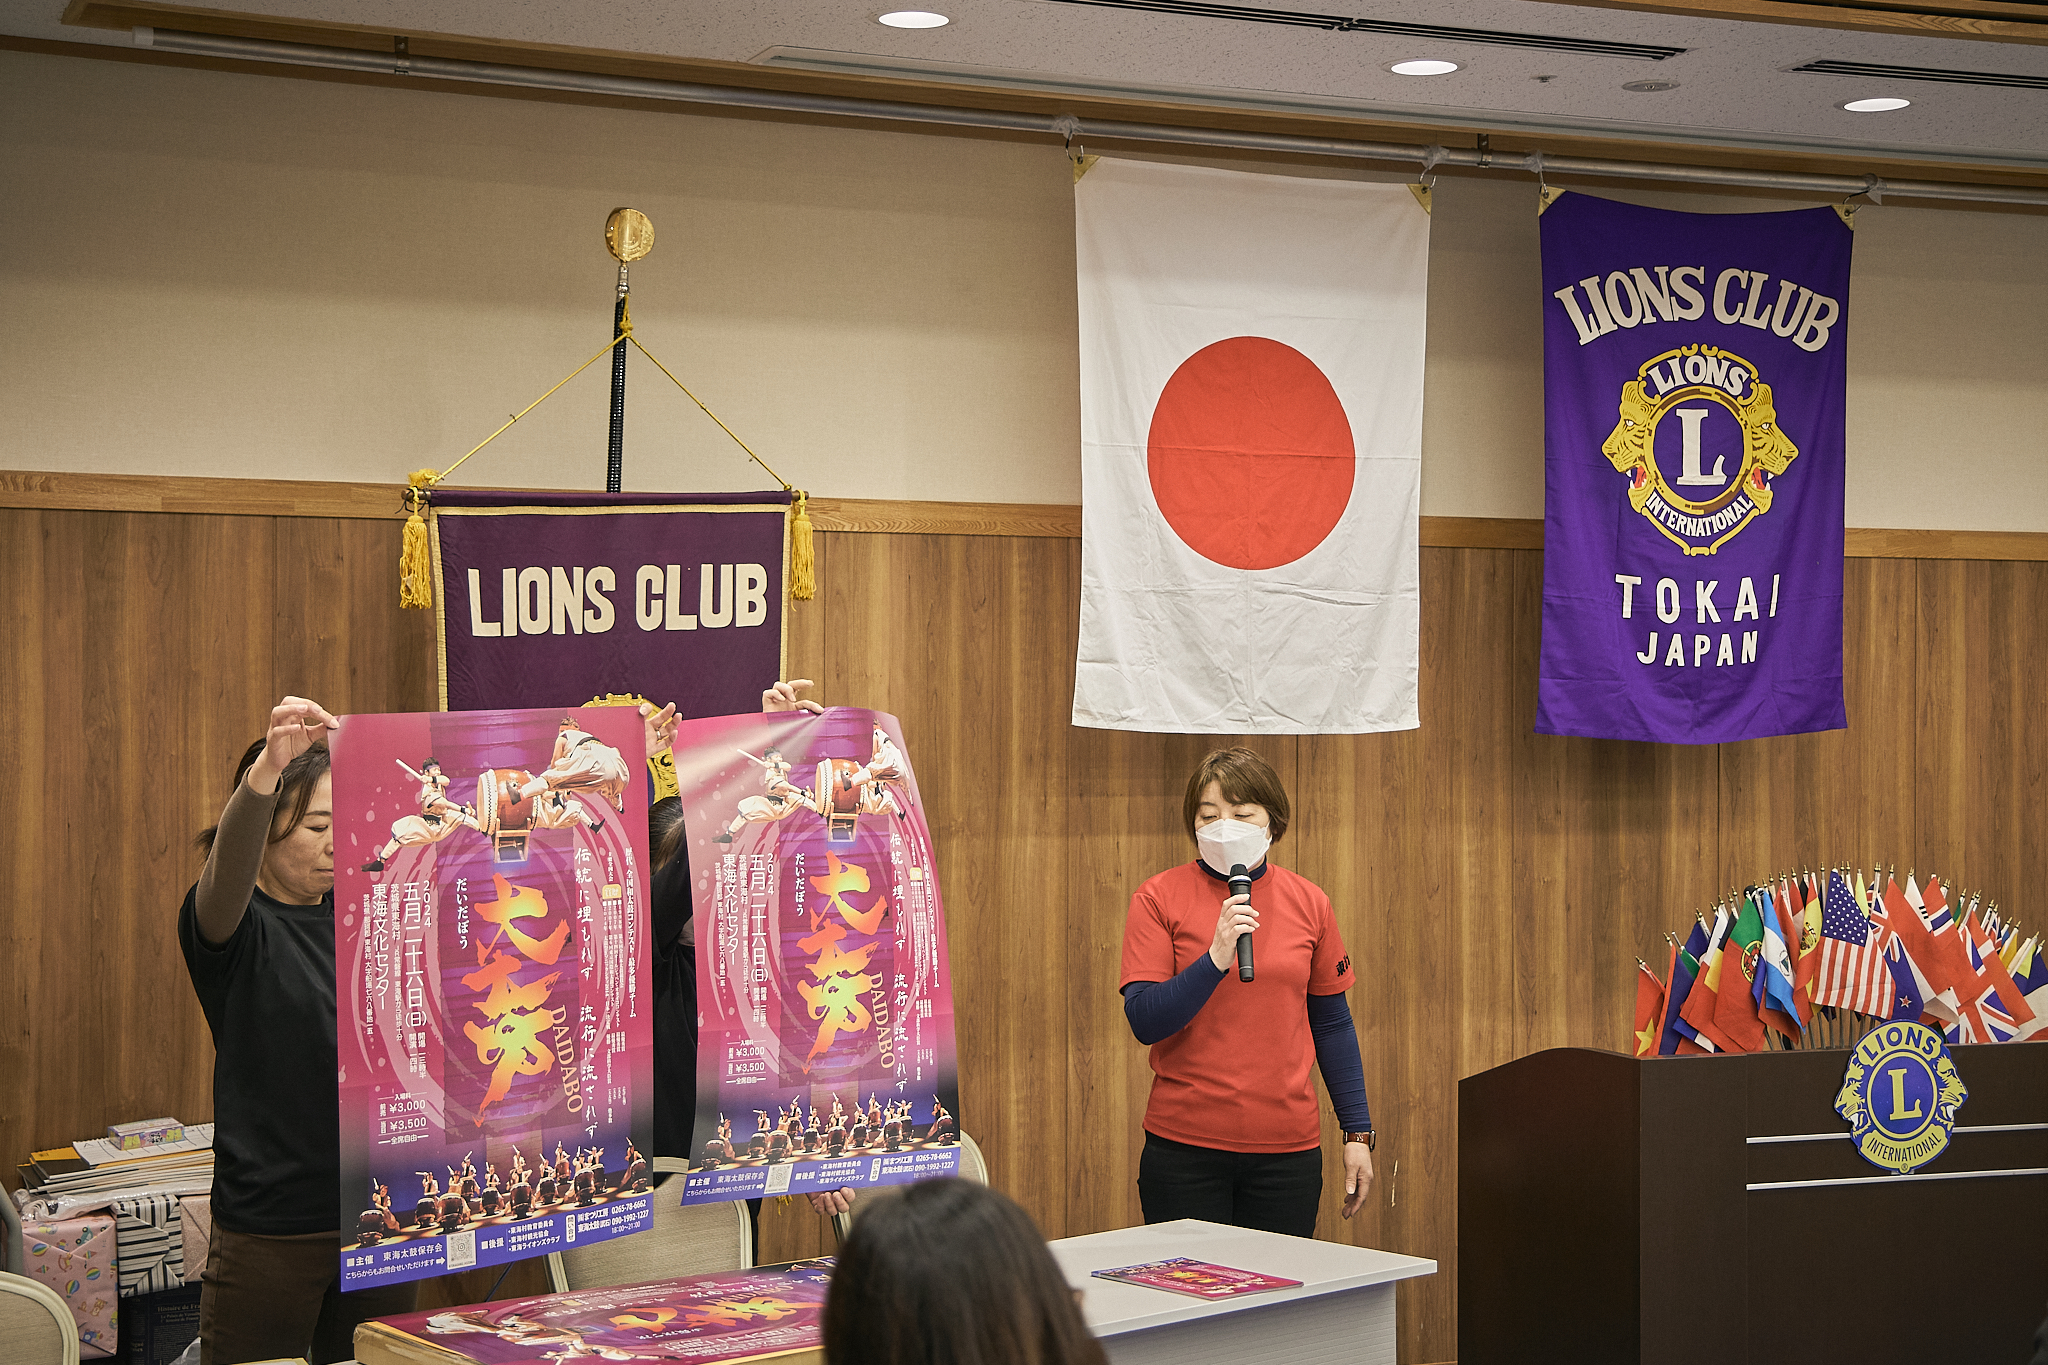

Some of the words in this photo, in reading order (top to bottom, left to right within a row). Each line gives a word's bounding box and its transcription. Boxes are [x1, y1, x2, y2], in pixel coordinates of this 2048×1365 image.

[1554, 265, 1705, 346] LIONS
[1712, 267, 1840, 352] CLUB
[1647, 354, 1749, 395] LIONS
[1675, 408, 1727, 485] L
[1645, 490, 1754, 537] INTERNATIONAL
[468, 566, 616, 637] LIONS
[635, 563, 768, 631] CLUB
[1615, 573, 1780, 624] TOKAI
[1636, 630, 1758, 667] JAPAN
[767, 852, 775, 895] 2024
[795, 852, 806, 917] だいだぼう
[890, 832, 905, 952] 伝統に埋もれず
[423, 880, 432, 928] 2024
[456, 877, 470, 949] だいだぼう
[575, 847, 595, 982] 伝統に埋もれず
[722, 853, 738, 965] 東海文化センター
[372, 882, 389, 1010] 東海文化センター
[869, 971, 896, 1069] DAIDABO
[1862, 1026, 1937, 1061] LIONS
[551, 1005, 584, 1113] DAIDABO
[580, 1005, 598, 1140] 流行に流されず
[735, 1046, 765, 1057] ¥3,000
[735, 1061, 765, 1073] ¥3,500
[389, 1099, 426, 1113] ¥3,000
[1888, 1068, 1922, 1120] L
[390, 1116, 427, 1131] ¥3,500
[391, 1134, 418, 1145] 全席自由
[1866, 1132, 1941, 1162] INTERNATIONAL
[611, 1199, 647, 1215] 0265-78-6662
[612, 1209, 649, 1226] 090-1992-1227
[355, 1254, 374, 1266] 主催
[383, 1242, 443, 1262] 東海太鼓保存会
[489, 1237, 504, 1248] 後援
